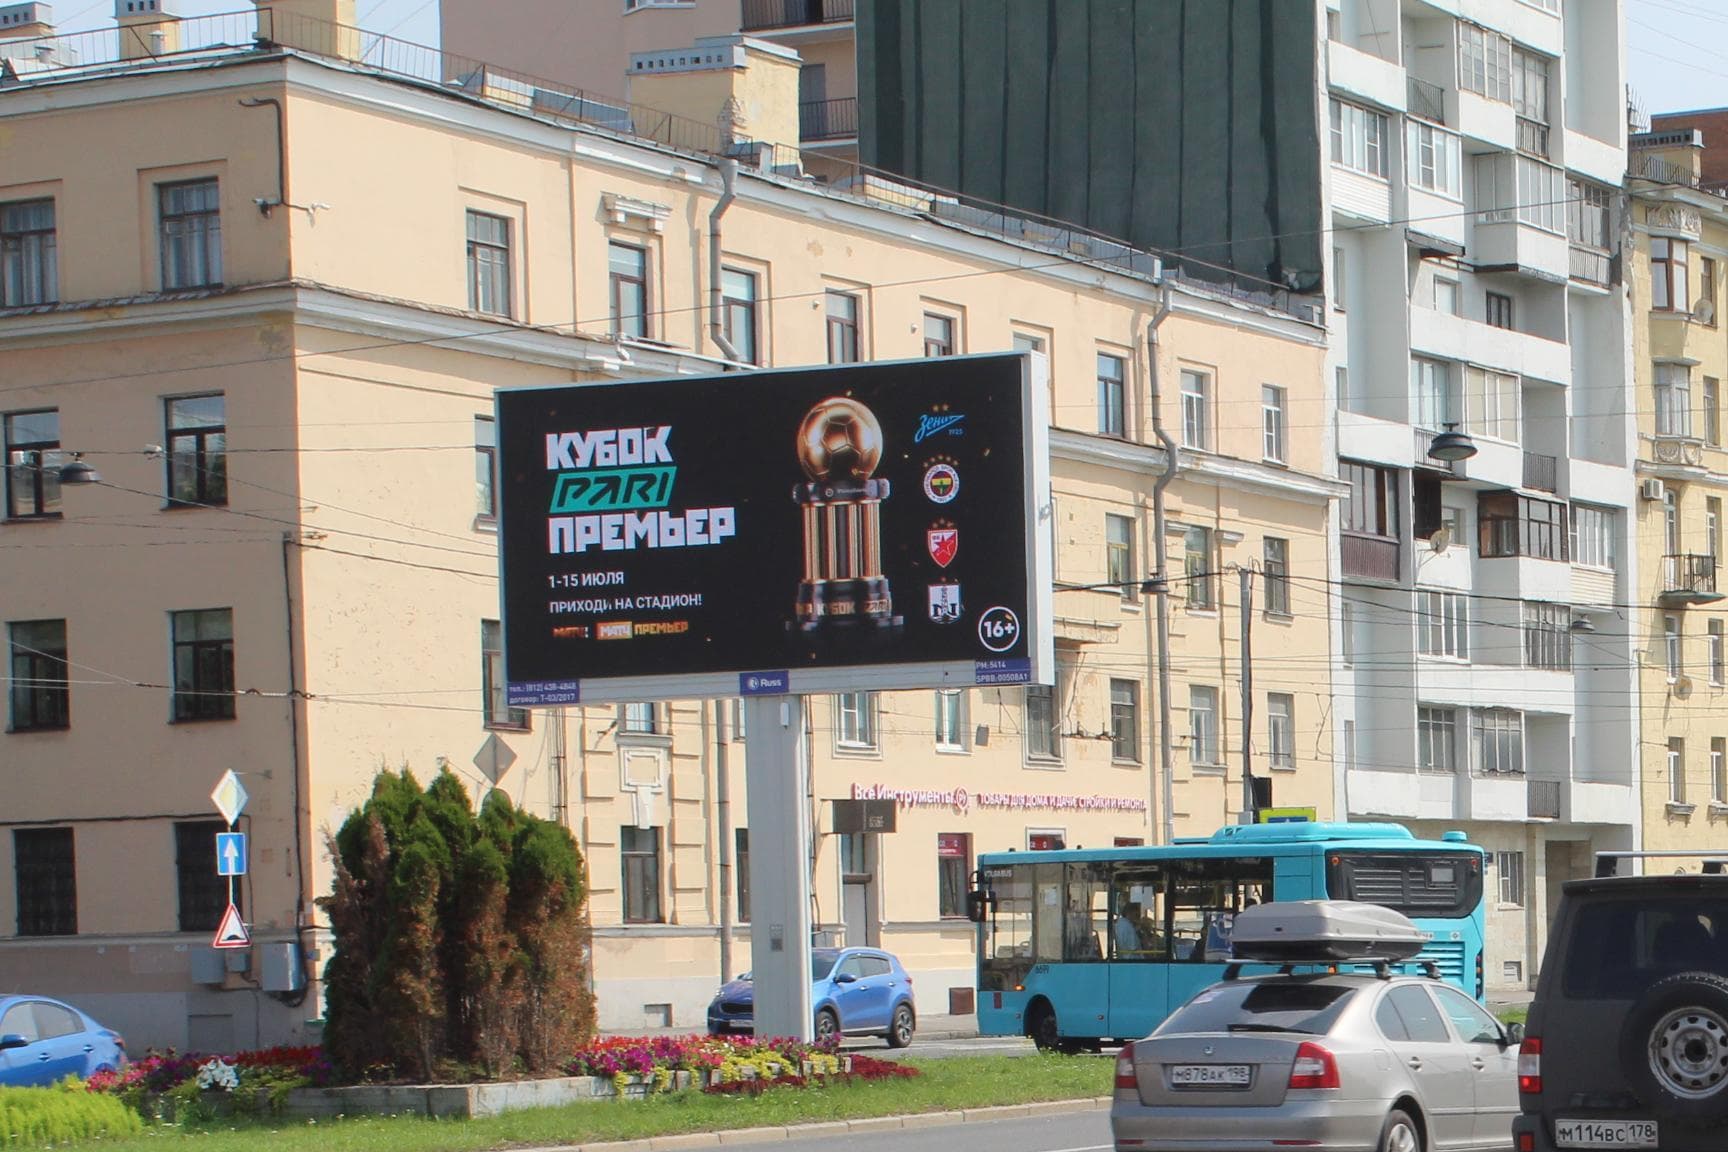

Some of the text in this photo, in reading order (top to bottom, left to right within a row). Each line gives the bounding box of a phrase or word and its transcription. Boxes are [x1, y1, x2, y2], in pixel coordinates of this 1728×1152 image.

[546, 426, 673, 470] КУБОК
[557, 472, 670, 507] PARI
[549, 507, 736, 554] ПРЕМЬЕР
[549, 572, 625, 588] 1-15 ИЮЛЯ
[550, 594, 703, 613] ПРИХОДИ НА СТАДИОН!
[634, 621, 689, 635] ПРЕМЬЕР
[983, 621, 1015, 638] 16+
[761, 678, 782, 688] Russ
[1027, 795, 1048, 807] ДОМА
[1629, 1125, 1652, 1137] 178
